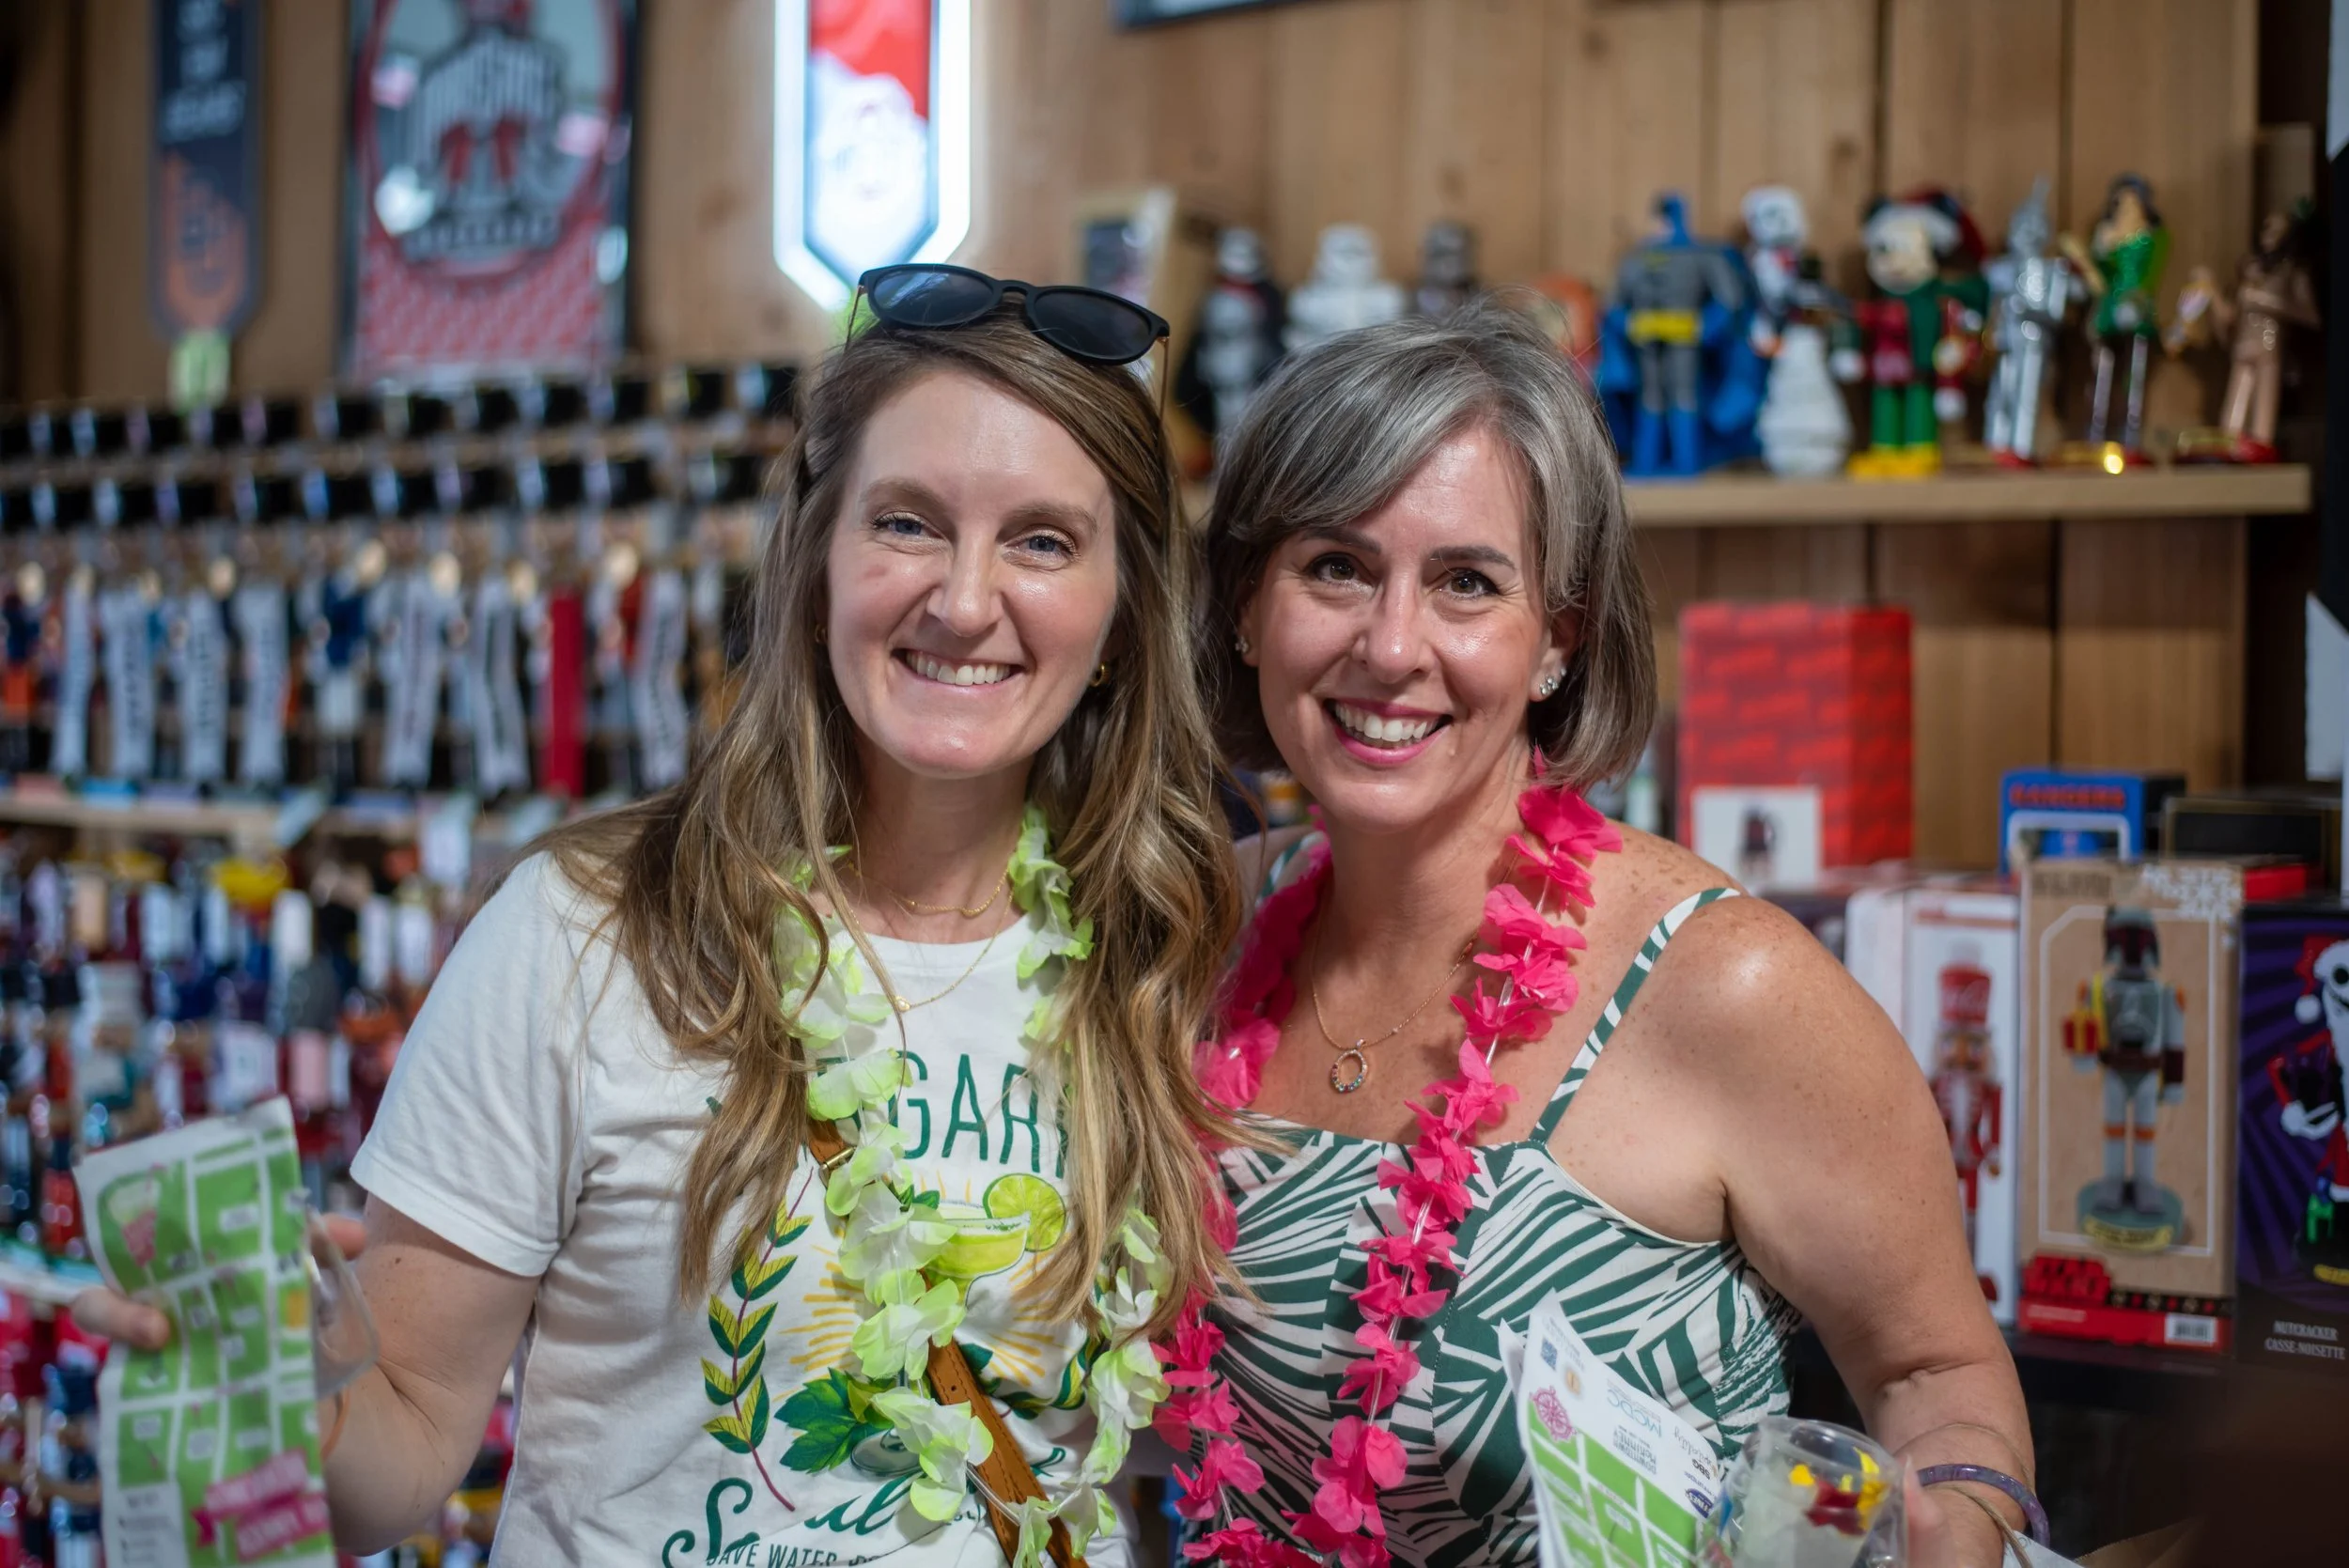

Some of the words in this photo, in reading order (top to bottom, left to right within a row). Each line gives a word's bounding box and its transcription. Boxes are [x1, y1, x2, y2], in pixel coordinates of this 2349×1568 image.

[2274, 1320, 2338, 1341] NUTCRACKER
[2264, 1337, 2345, 1360] CASSE-NOISETTE
[1691, 1458, 1711, 1481] SBG
